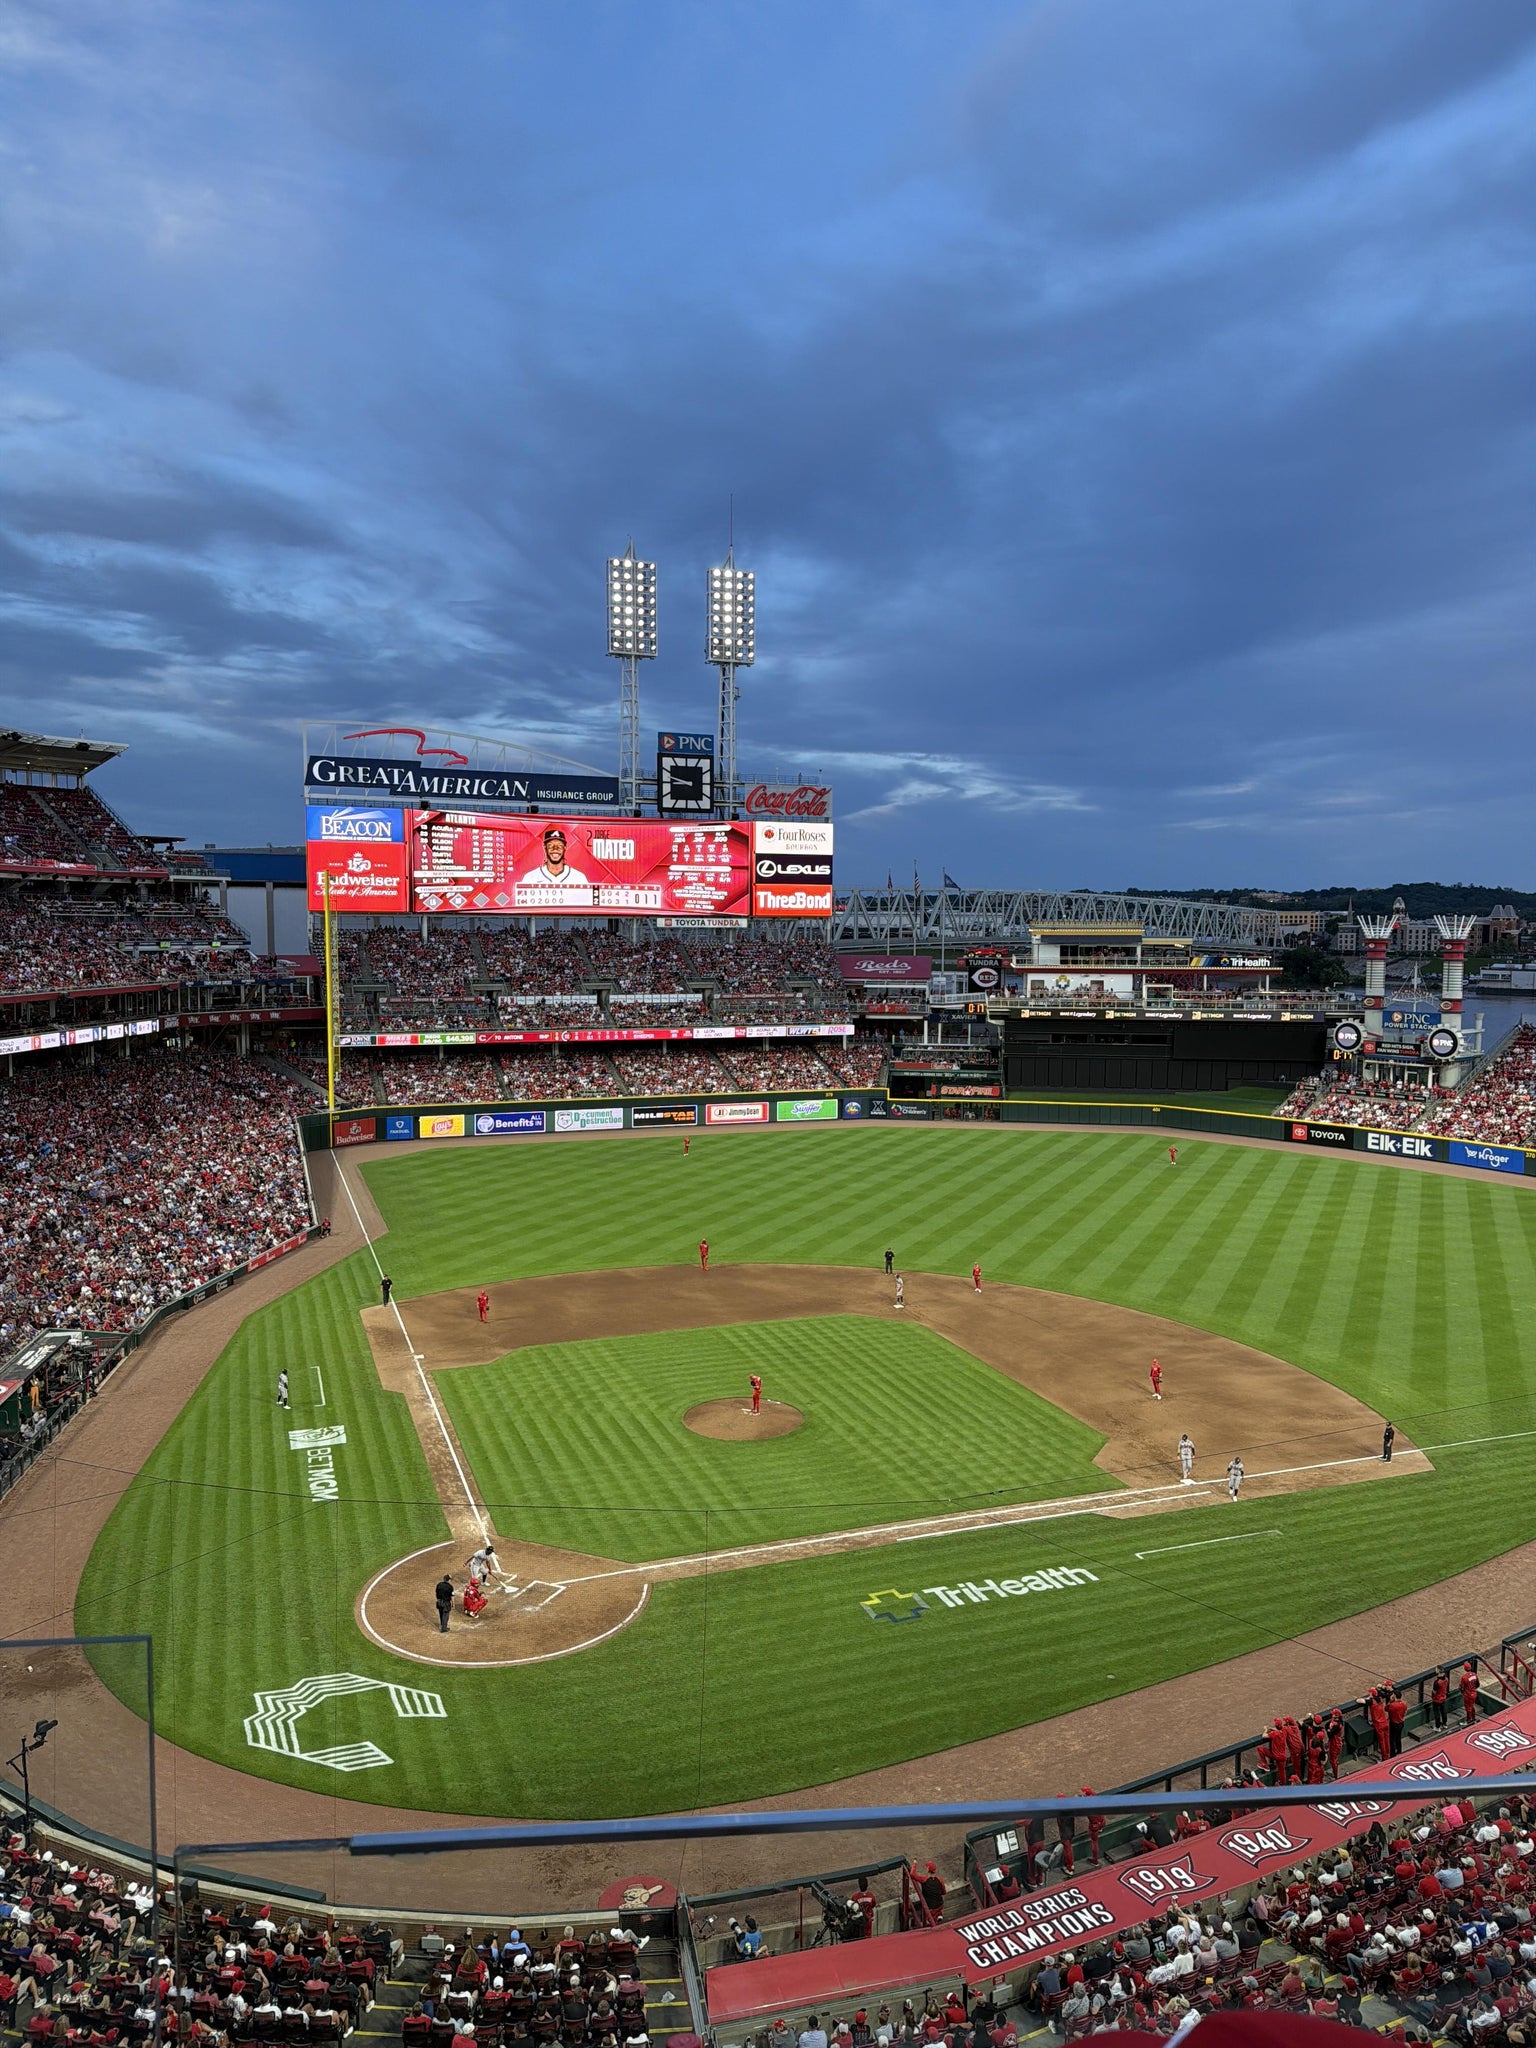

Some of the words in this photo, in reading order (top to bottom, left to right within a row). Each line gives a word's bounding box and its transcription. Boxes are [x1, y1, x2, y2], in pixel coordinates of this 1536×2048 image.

[679, 736, 712, 751] PNC
[537, 789, 585, 800] INSURANCE
[587, 792, 615, 801] GROUP
[745, 784, 832, 816] Coca-Cola
[445, 813, 476, 825] ATLANTA
[321, 815, 392, 837] BEACON
[778, 828, 797, 841] Four
[799, 828, 826, 842] Roses
[592, 839, 635, 860] MATEO
[777, 864, 831, 875] LEXUS
[348, 888, 358, 898] of
[357, 887, 398, 897] America
[634, 893, 640, 904] 0
[757, 891, 831, 909] ThreeBond
[674, 919, 706, 927] TOYOTA
[706, 919, 741, 927] TUNDRA
[854, 959, 912, 971] Reds
[969, 959, 999, 967] TUNDRA
[1230, 957, 1270, 967] TriHealth
[968, 1003, 985, 1013] 0:17
[1247, 1013, 1272, 1021] Legendary
[1404, 1014, 1430, 1024] PNC
[1344, 1033, 1358, 1041] PNC
[791, 1102, 821, 1115] Swiffer
[574, 1110, 613, 1122] Document
[580, 1114, 622, 1128] Destruction
[634, 1111, 695, 1119] MILESTAR
[495, 1118, 534, 1128] Benefits
[336, 1133, 375, 1145] Budweiser
[1310, 1130, 1346, 1141] TOYOTA
[1478, 1148, 1510, 1167] Kroger
[307, 1447, 339, 1502] BETMGM
[922, 1566, 1099, 1608] TriHealth
[1473, 1729, 1531, 1754] 1990
[1399, 1761, 1460, 1780] 1976
[1227, 1829, 1292, 1859] 1940
[1128, 1866, 1197, 1897] 1919
[957, 1909, 1025, 1943] WORLD
[1023, 1888, 1087, 1920] SERIES
[967, 1903, 1114, 1967] CHAMPIONS
